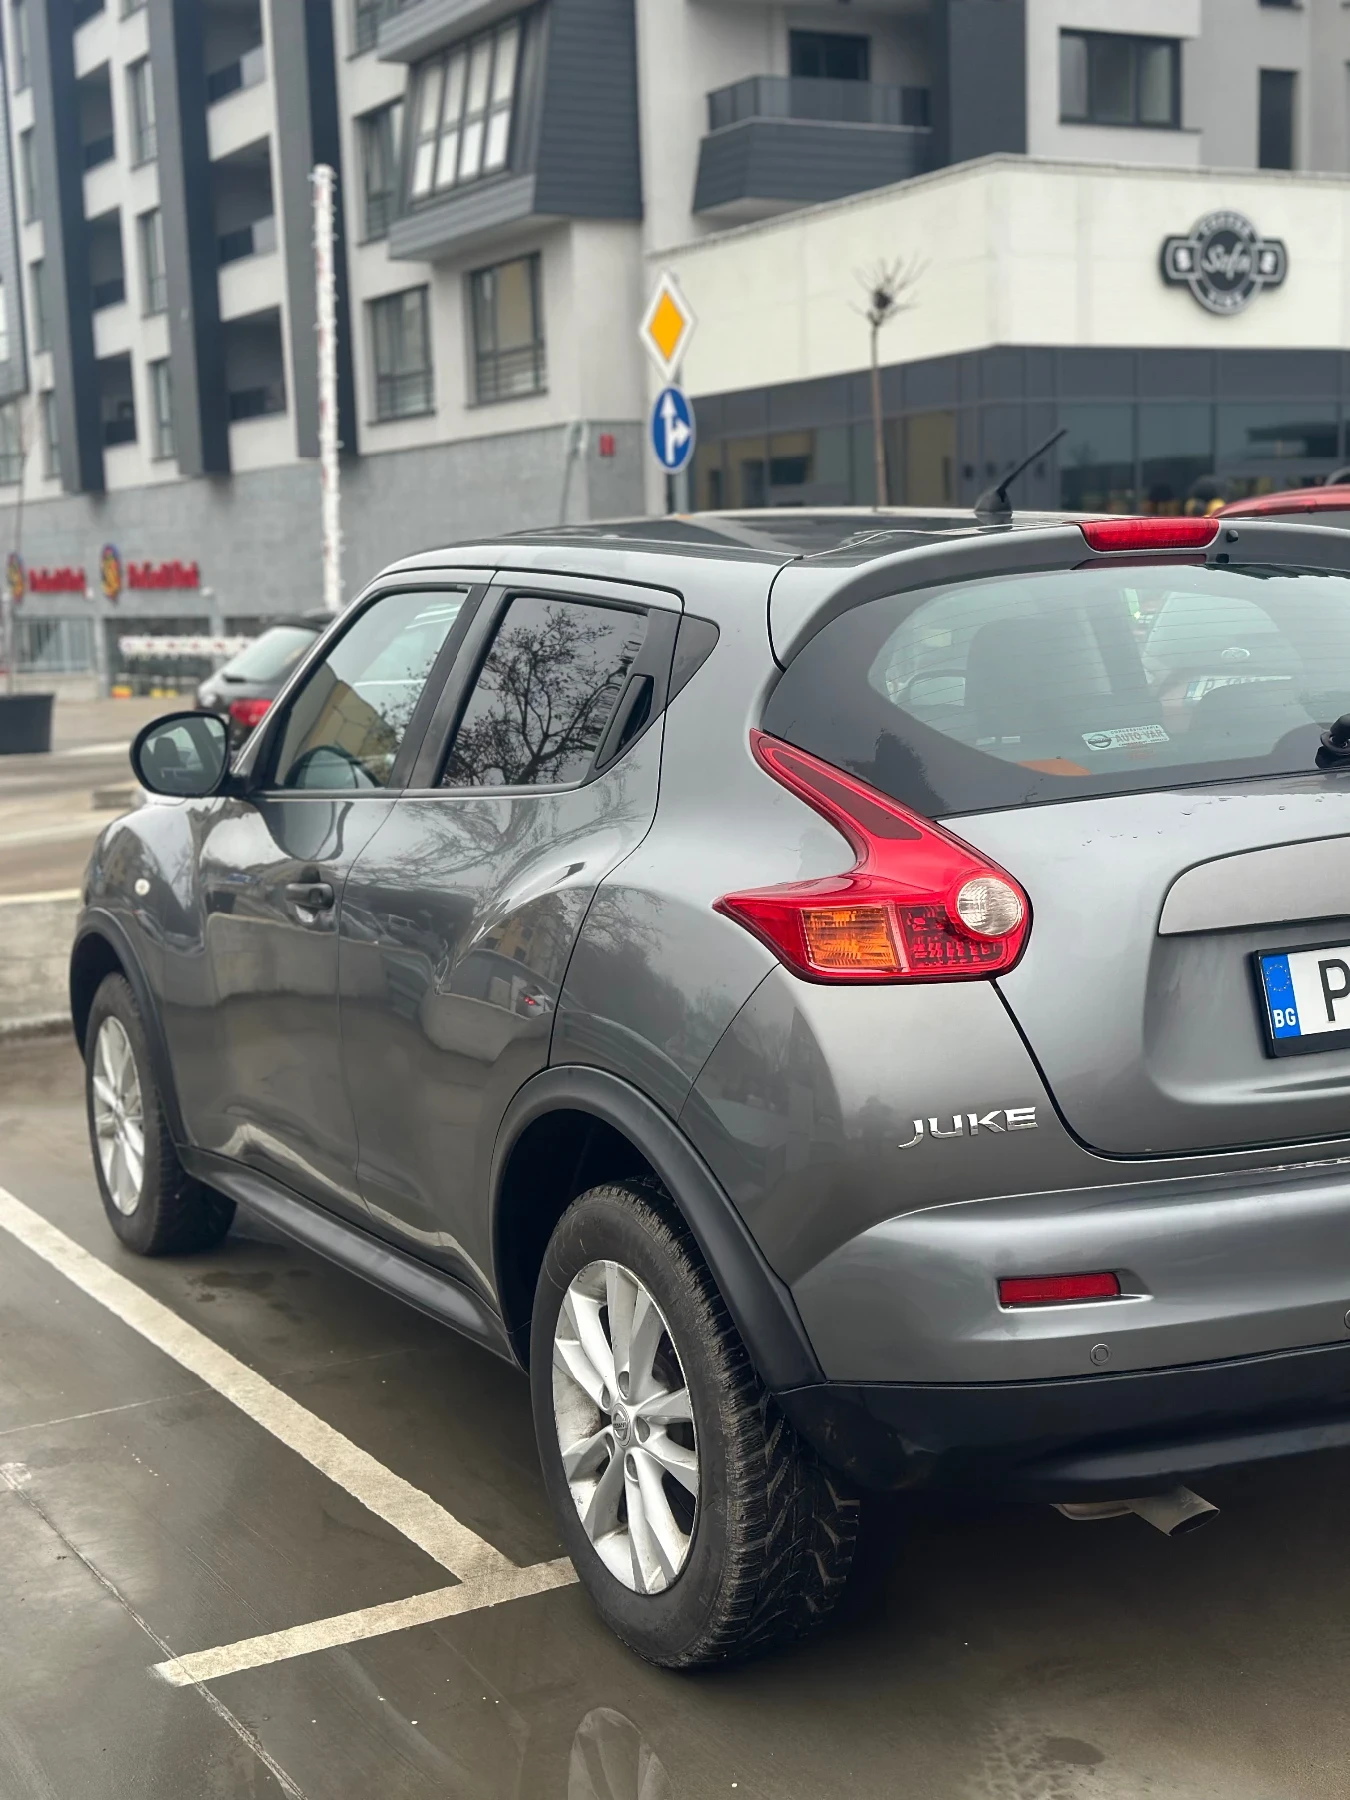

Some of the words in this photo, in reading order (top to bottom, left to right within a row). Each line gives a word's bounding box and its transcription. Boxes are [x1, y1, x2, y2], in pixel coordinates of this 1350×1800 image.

[1317, 958, 1350, 1022] P
[1273, 1007, 1297, 1028] BG
[898, 1106, 1039, 1150] JUKE
